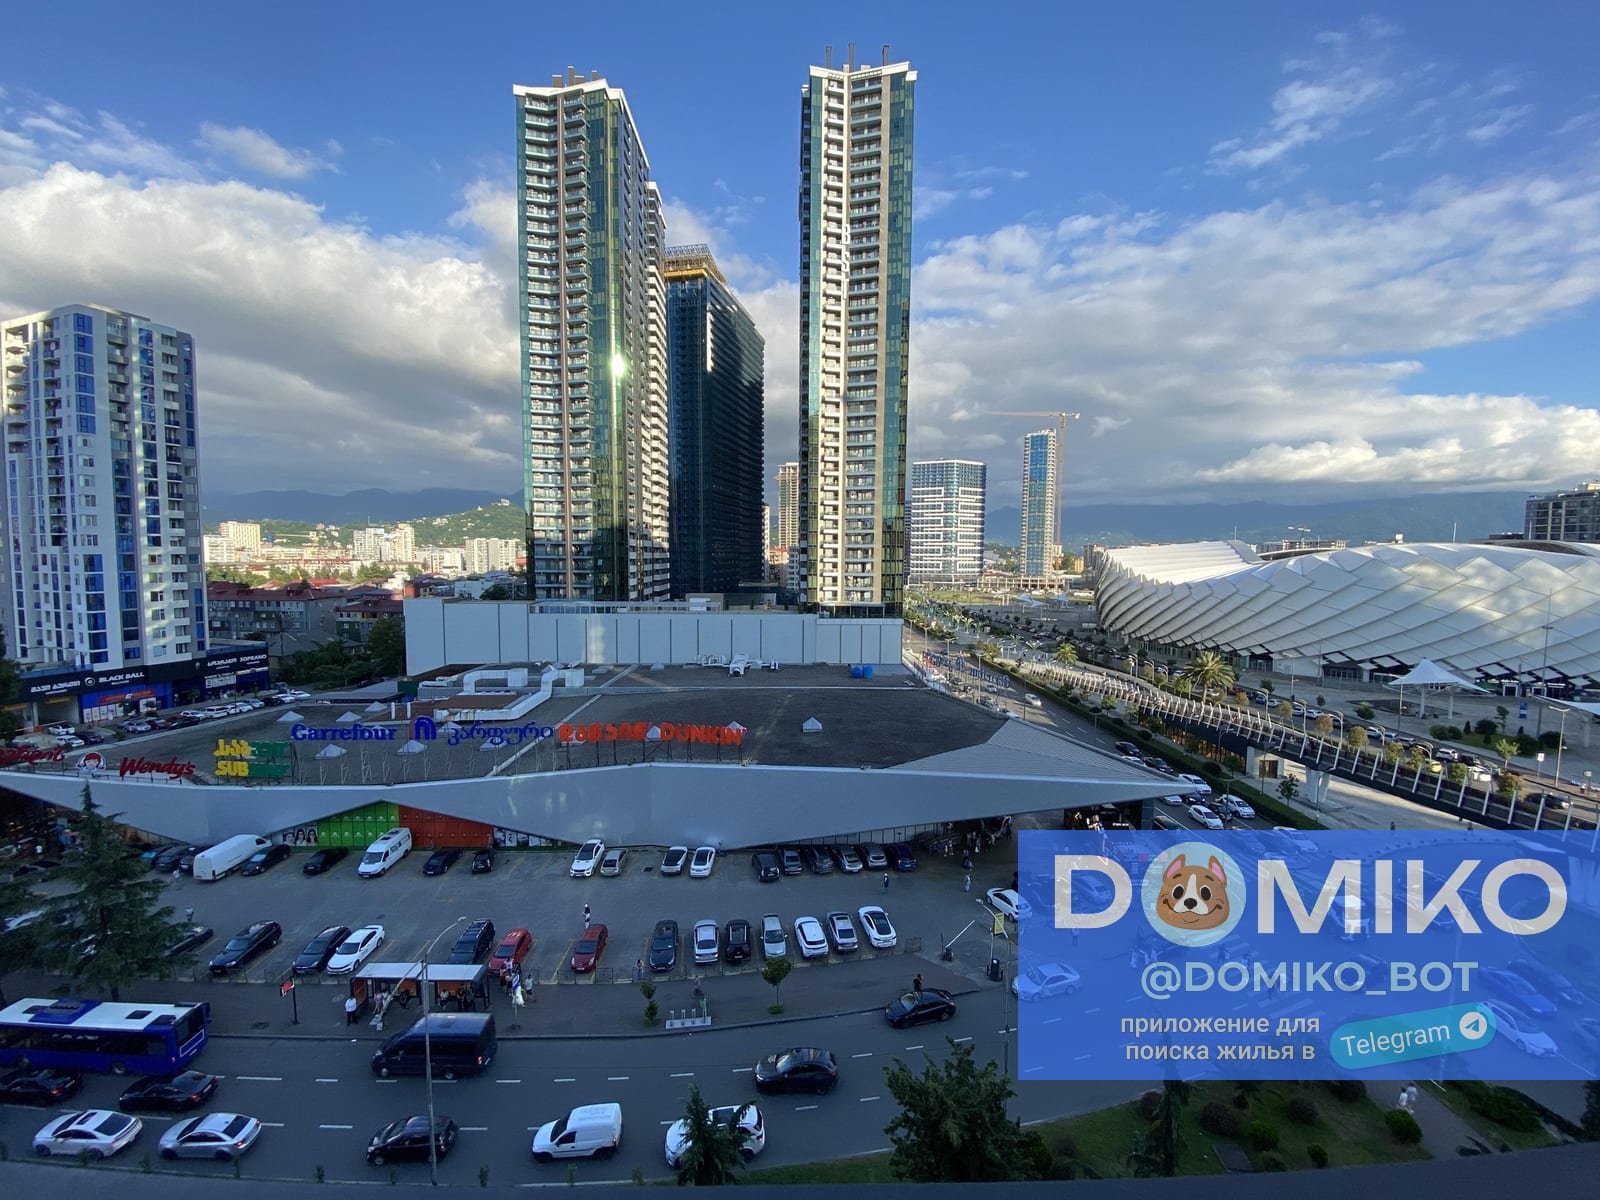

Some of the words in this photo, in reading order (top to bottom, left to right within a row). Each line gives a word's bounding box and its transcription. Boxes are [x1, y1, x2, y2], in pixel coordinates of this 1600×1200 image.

[98, 674, 124, 683] BLACK
[125, 672, 144, 680] BALL
[291, 723, 398, 741] Carrefour
[119, 756, 196, 779] Wendy's
